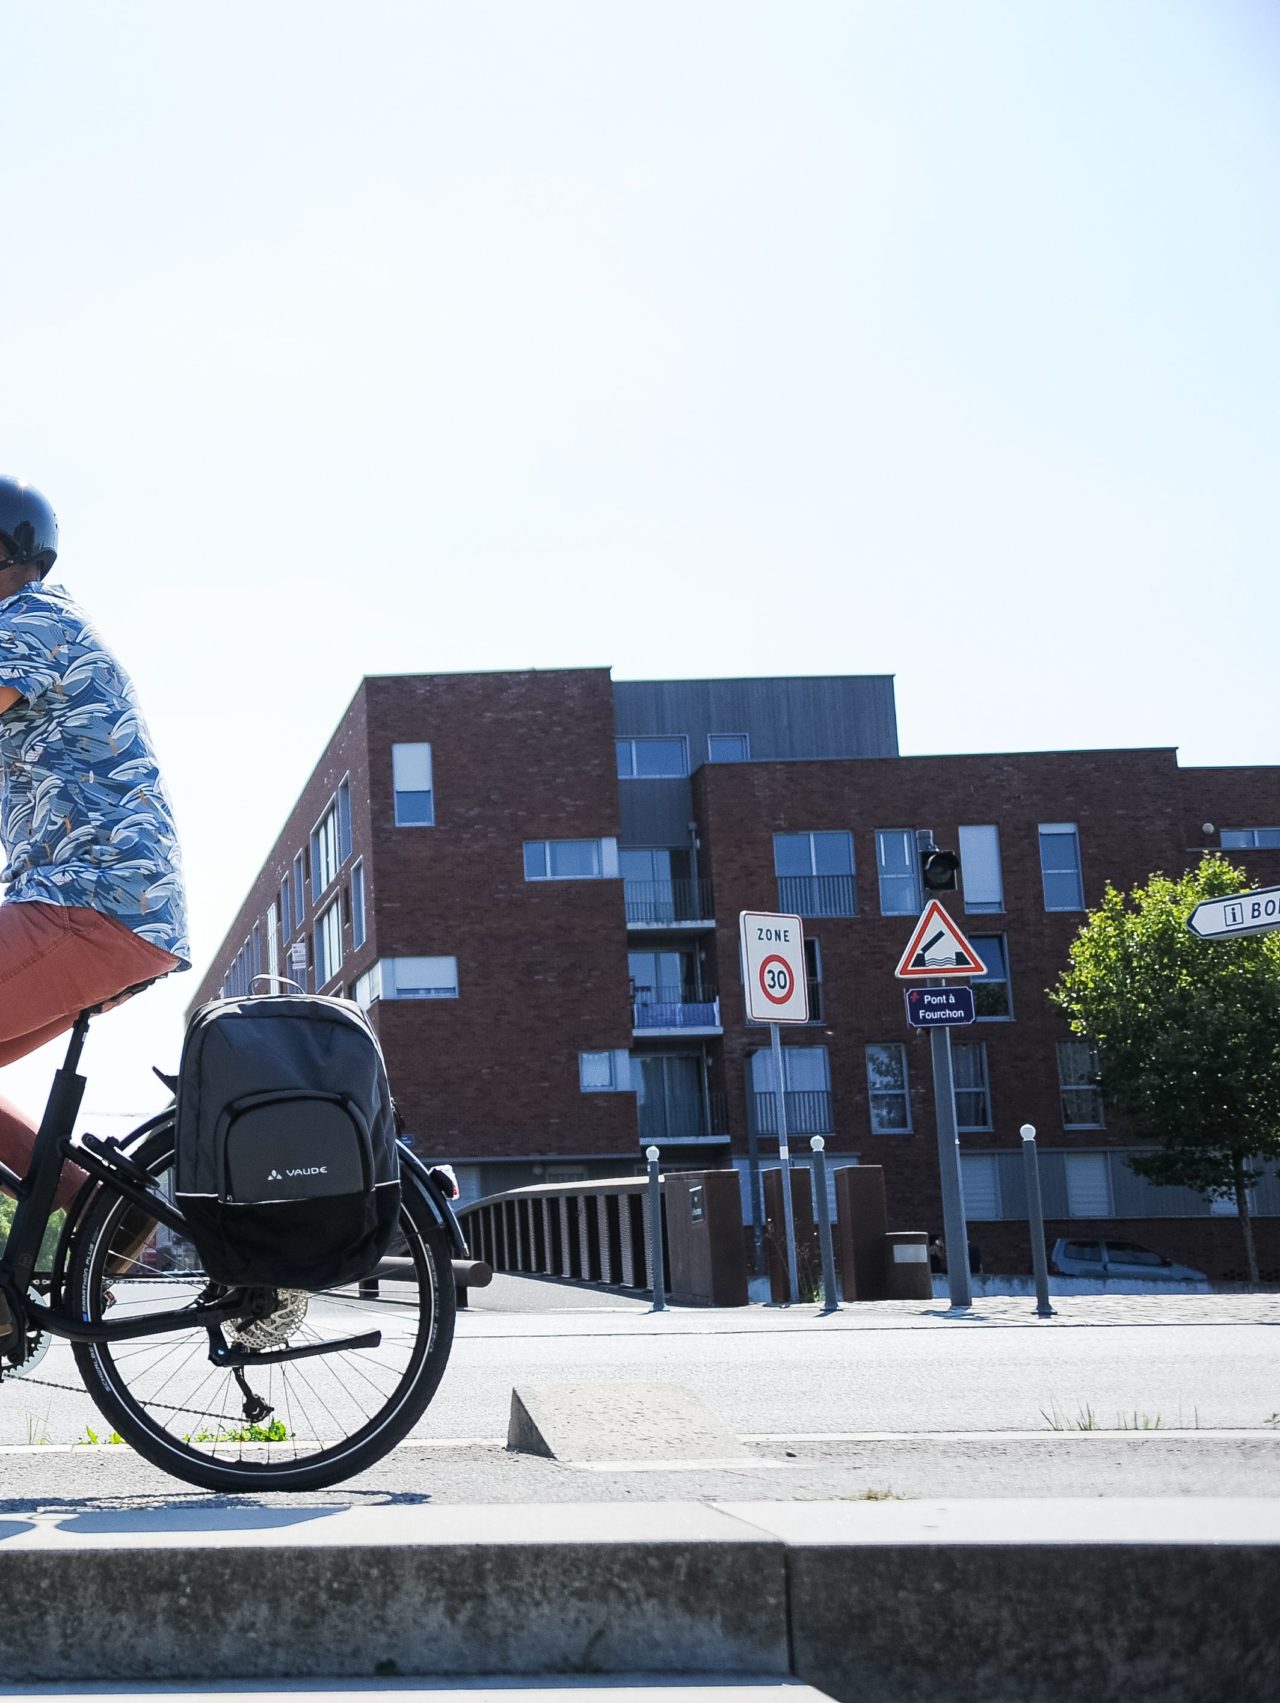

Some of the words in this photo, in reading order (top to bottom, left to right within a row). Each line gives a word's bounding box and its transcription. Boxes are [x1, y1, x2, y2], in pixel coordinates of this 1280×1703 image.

[1251, 898, 1280, 919] BO
[757, 928, 790, 942] ZONE
[766, 969, 787, 989] 30
[924, 995, 947, 1004] Pont
[949, 993, 955, 1003] à
[919, 1009, 964, 1019] Fourchon
[286, 1166, 327, 1176] VAUDE
[86, 1243, 95, 1265] PLUS
